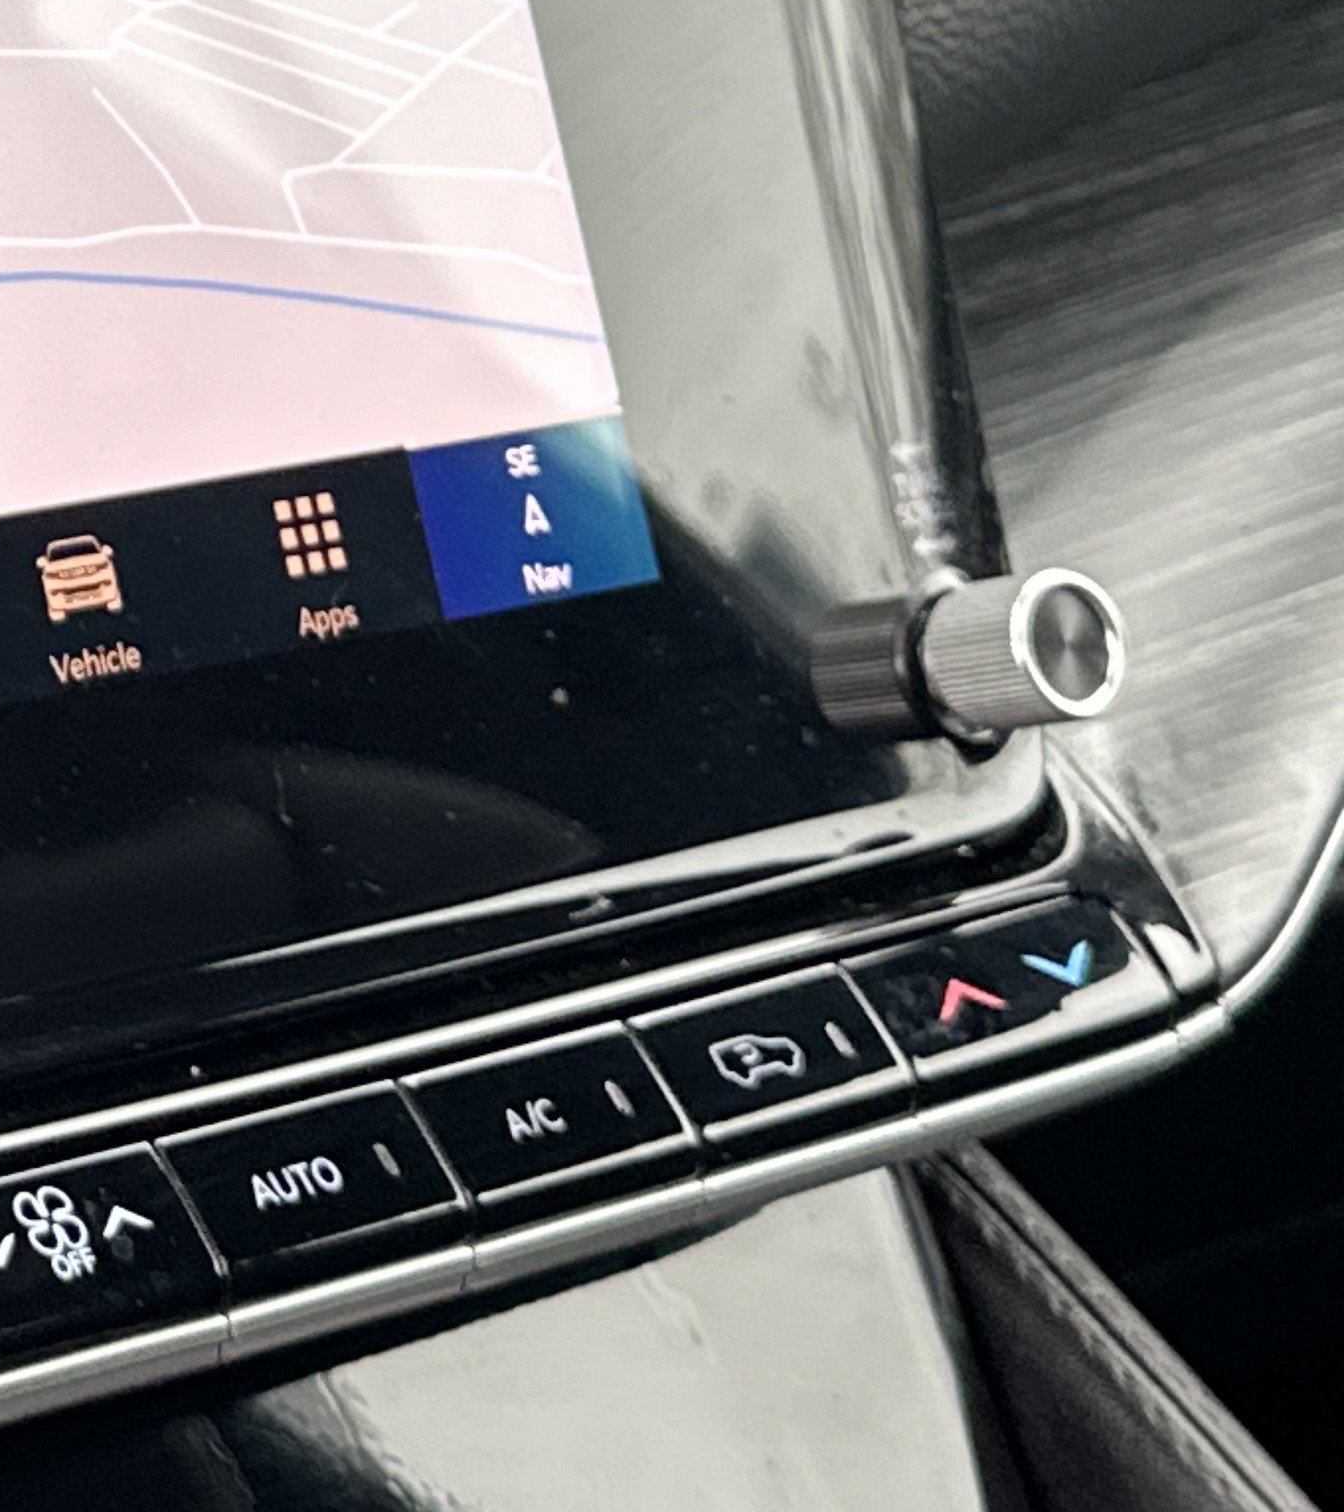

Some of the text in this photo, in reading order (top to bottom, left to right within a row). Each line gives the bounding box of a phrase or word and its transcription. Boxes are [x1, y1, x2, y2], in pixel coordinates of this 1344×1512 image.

[505, 444, 542, 479] SE
[522, 561, 573, 595] Nav
[296, 600, 360, 641] Apps
[48, 640, 143, 685] Vehicle
[504, 1097, 568, 1143] A/C
[249, 1155, 344, 1211] AUTO
[50, 1245, 97, 1282] OFF
